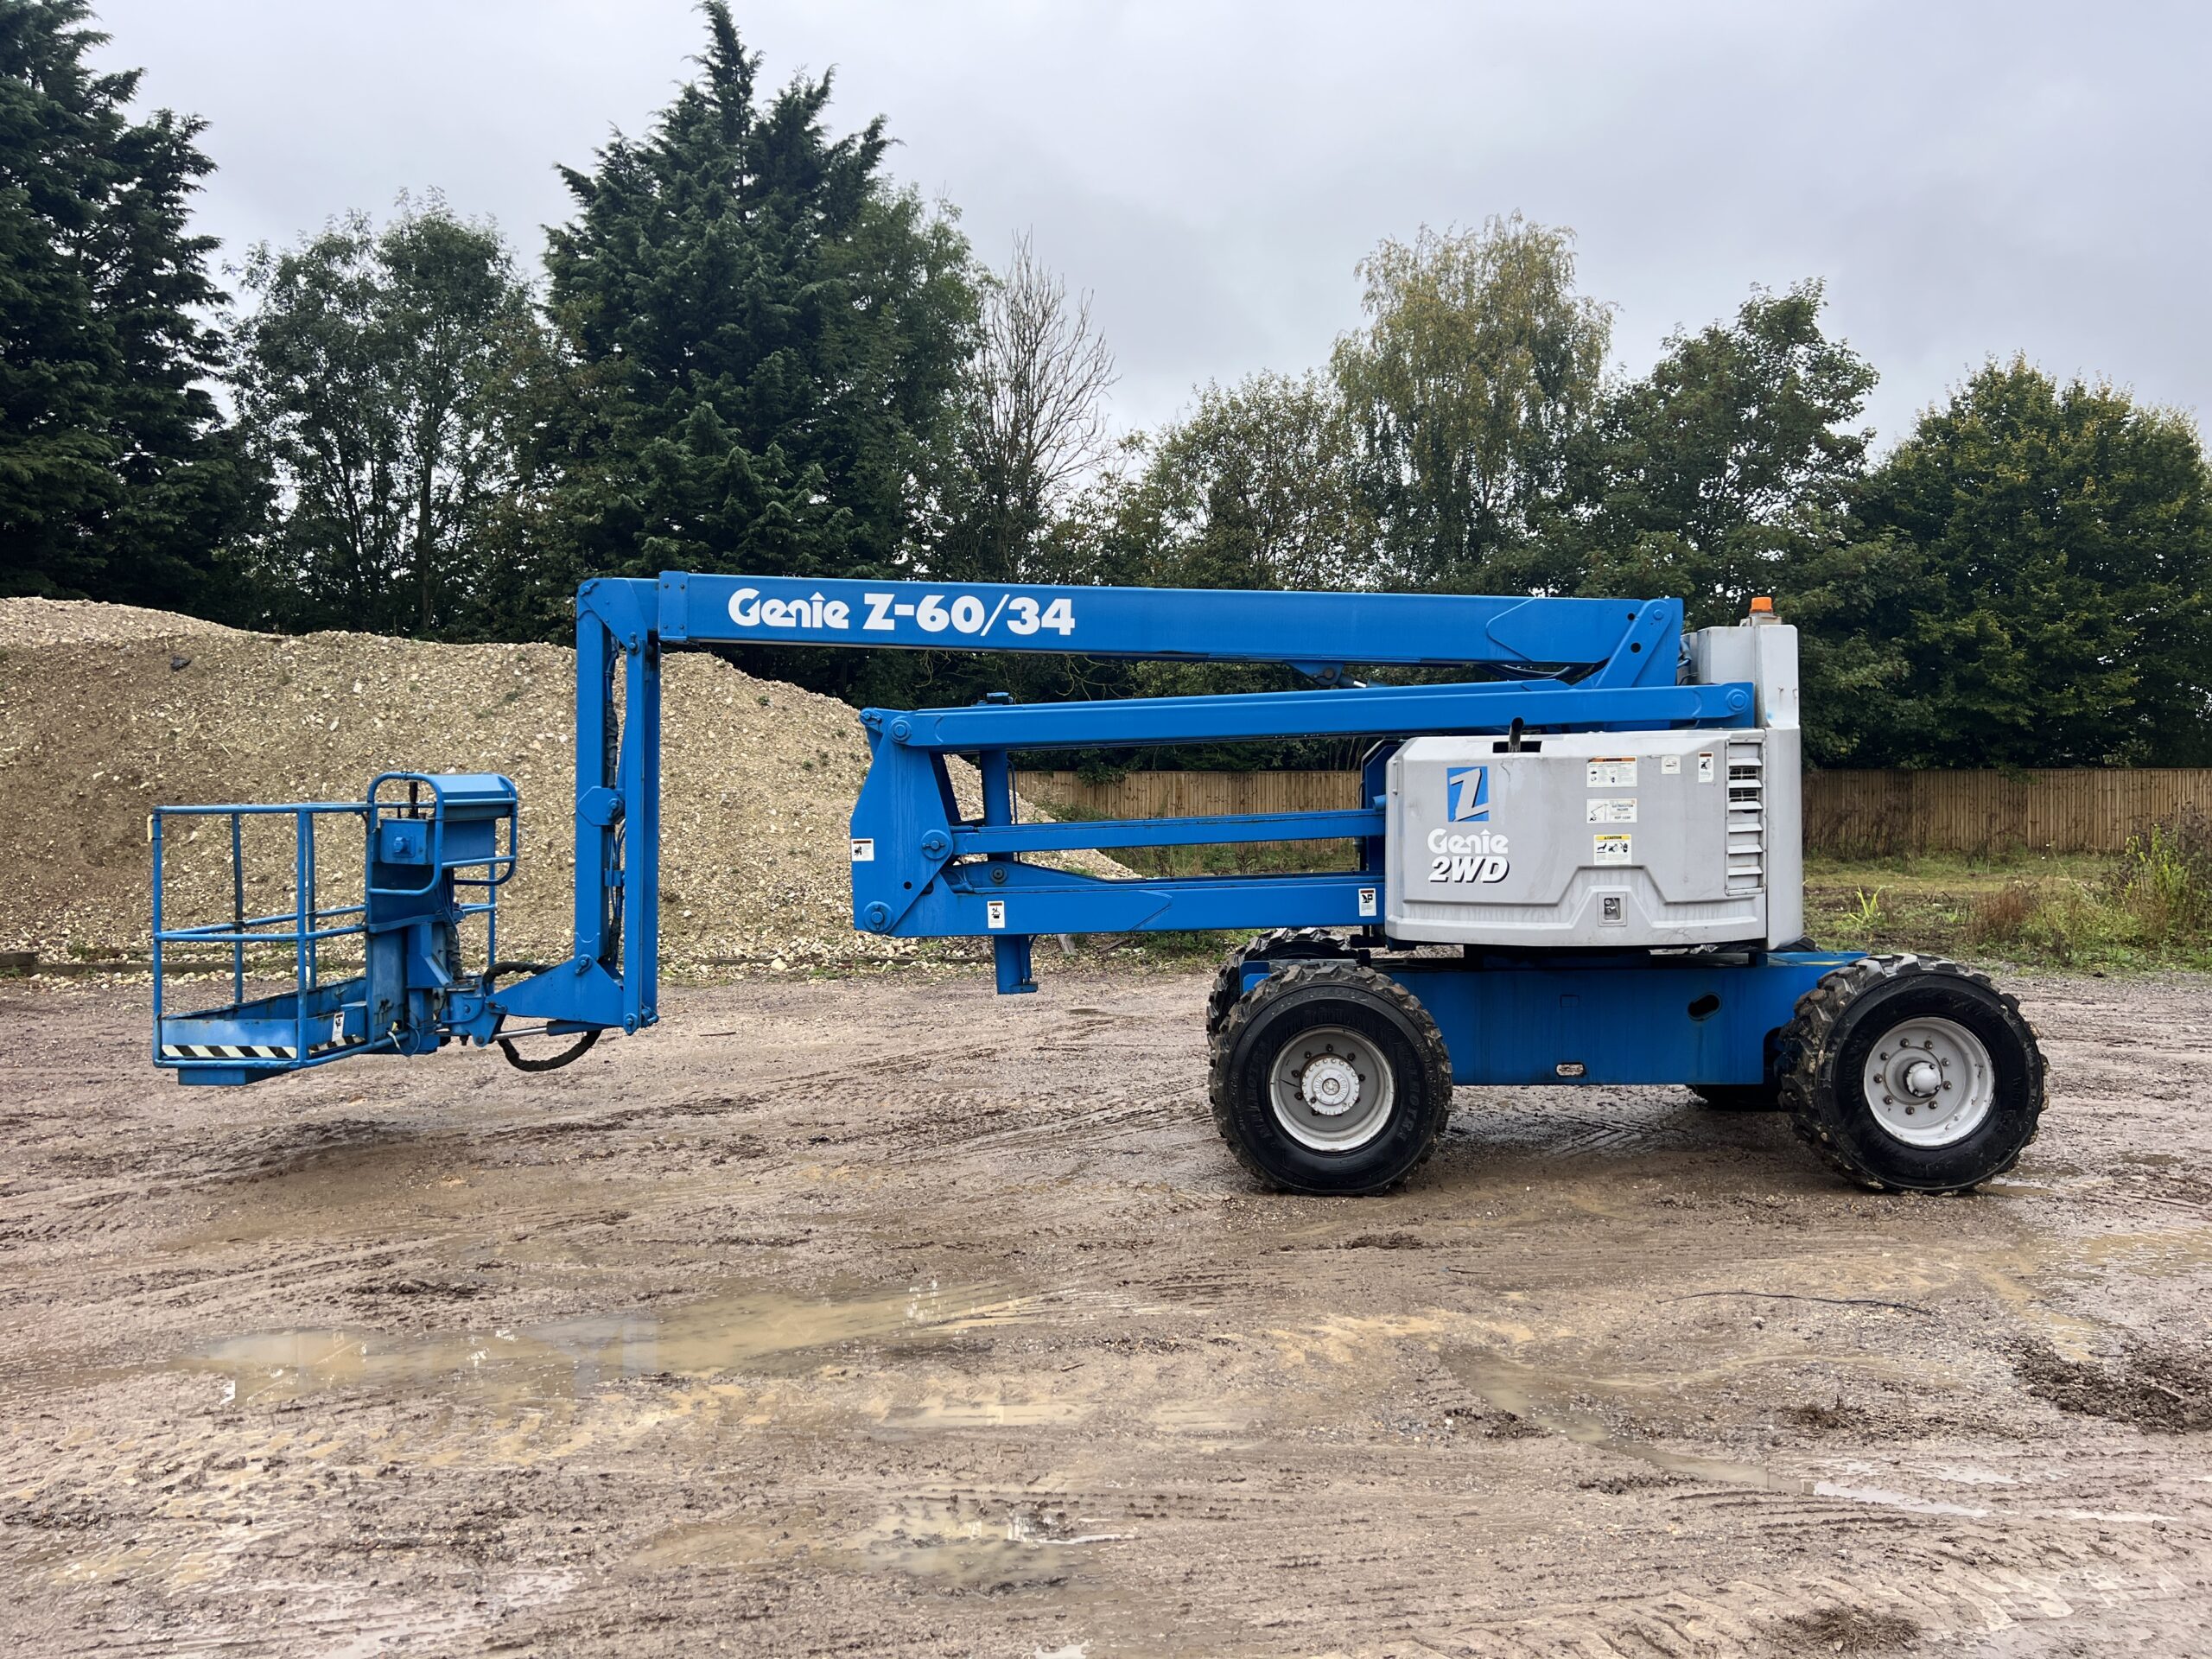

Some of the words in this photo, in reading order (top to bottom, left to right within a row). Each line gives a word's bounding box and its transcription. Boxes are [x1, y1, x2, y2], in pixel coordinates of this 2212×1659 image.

[728, 588, 850, 629] Genie
[862, 593, 1076, 637] Z-60/34
[1427, 828, 1510, 855] Genie
[1427, 855, 1510, 883] 2WD
